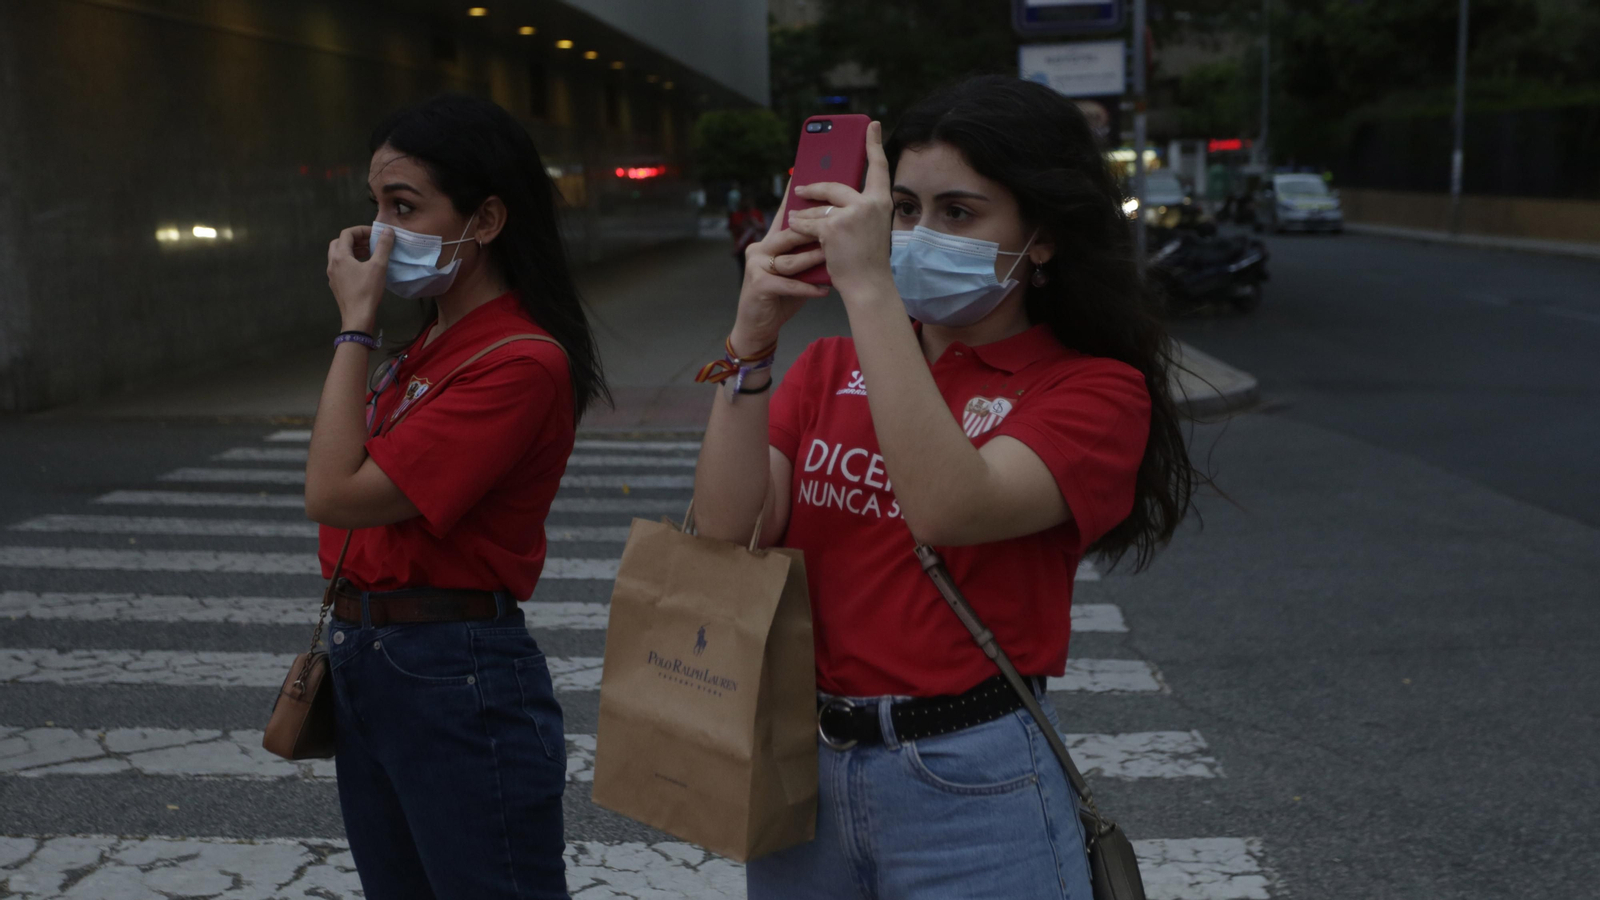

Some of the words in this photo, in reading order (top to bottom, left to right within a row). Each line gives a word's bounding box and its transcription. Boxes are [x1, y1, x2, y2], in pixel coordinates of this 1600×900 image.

[797, 478, 881, 518] NUNCA
[887, 498, 905, 520] S
[648, 651, 672, 670] POLO
[672, 658, 703, 681] RALPH
[703, 669, 738, 691] LAUREN
